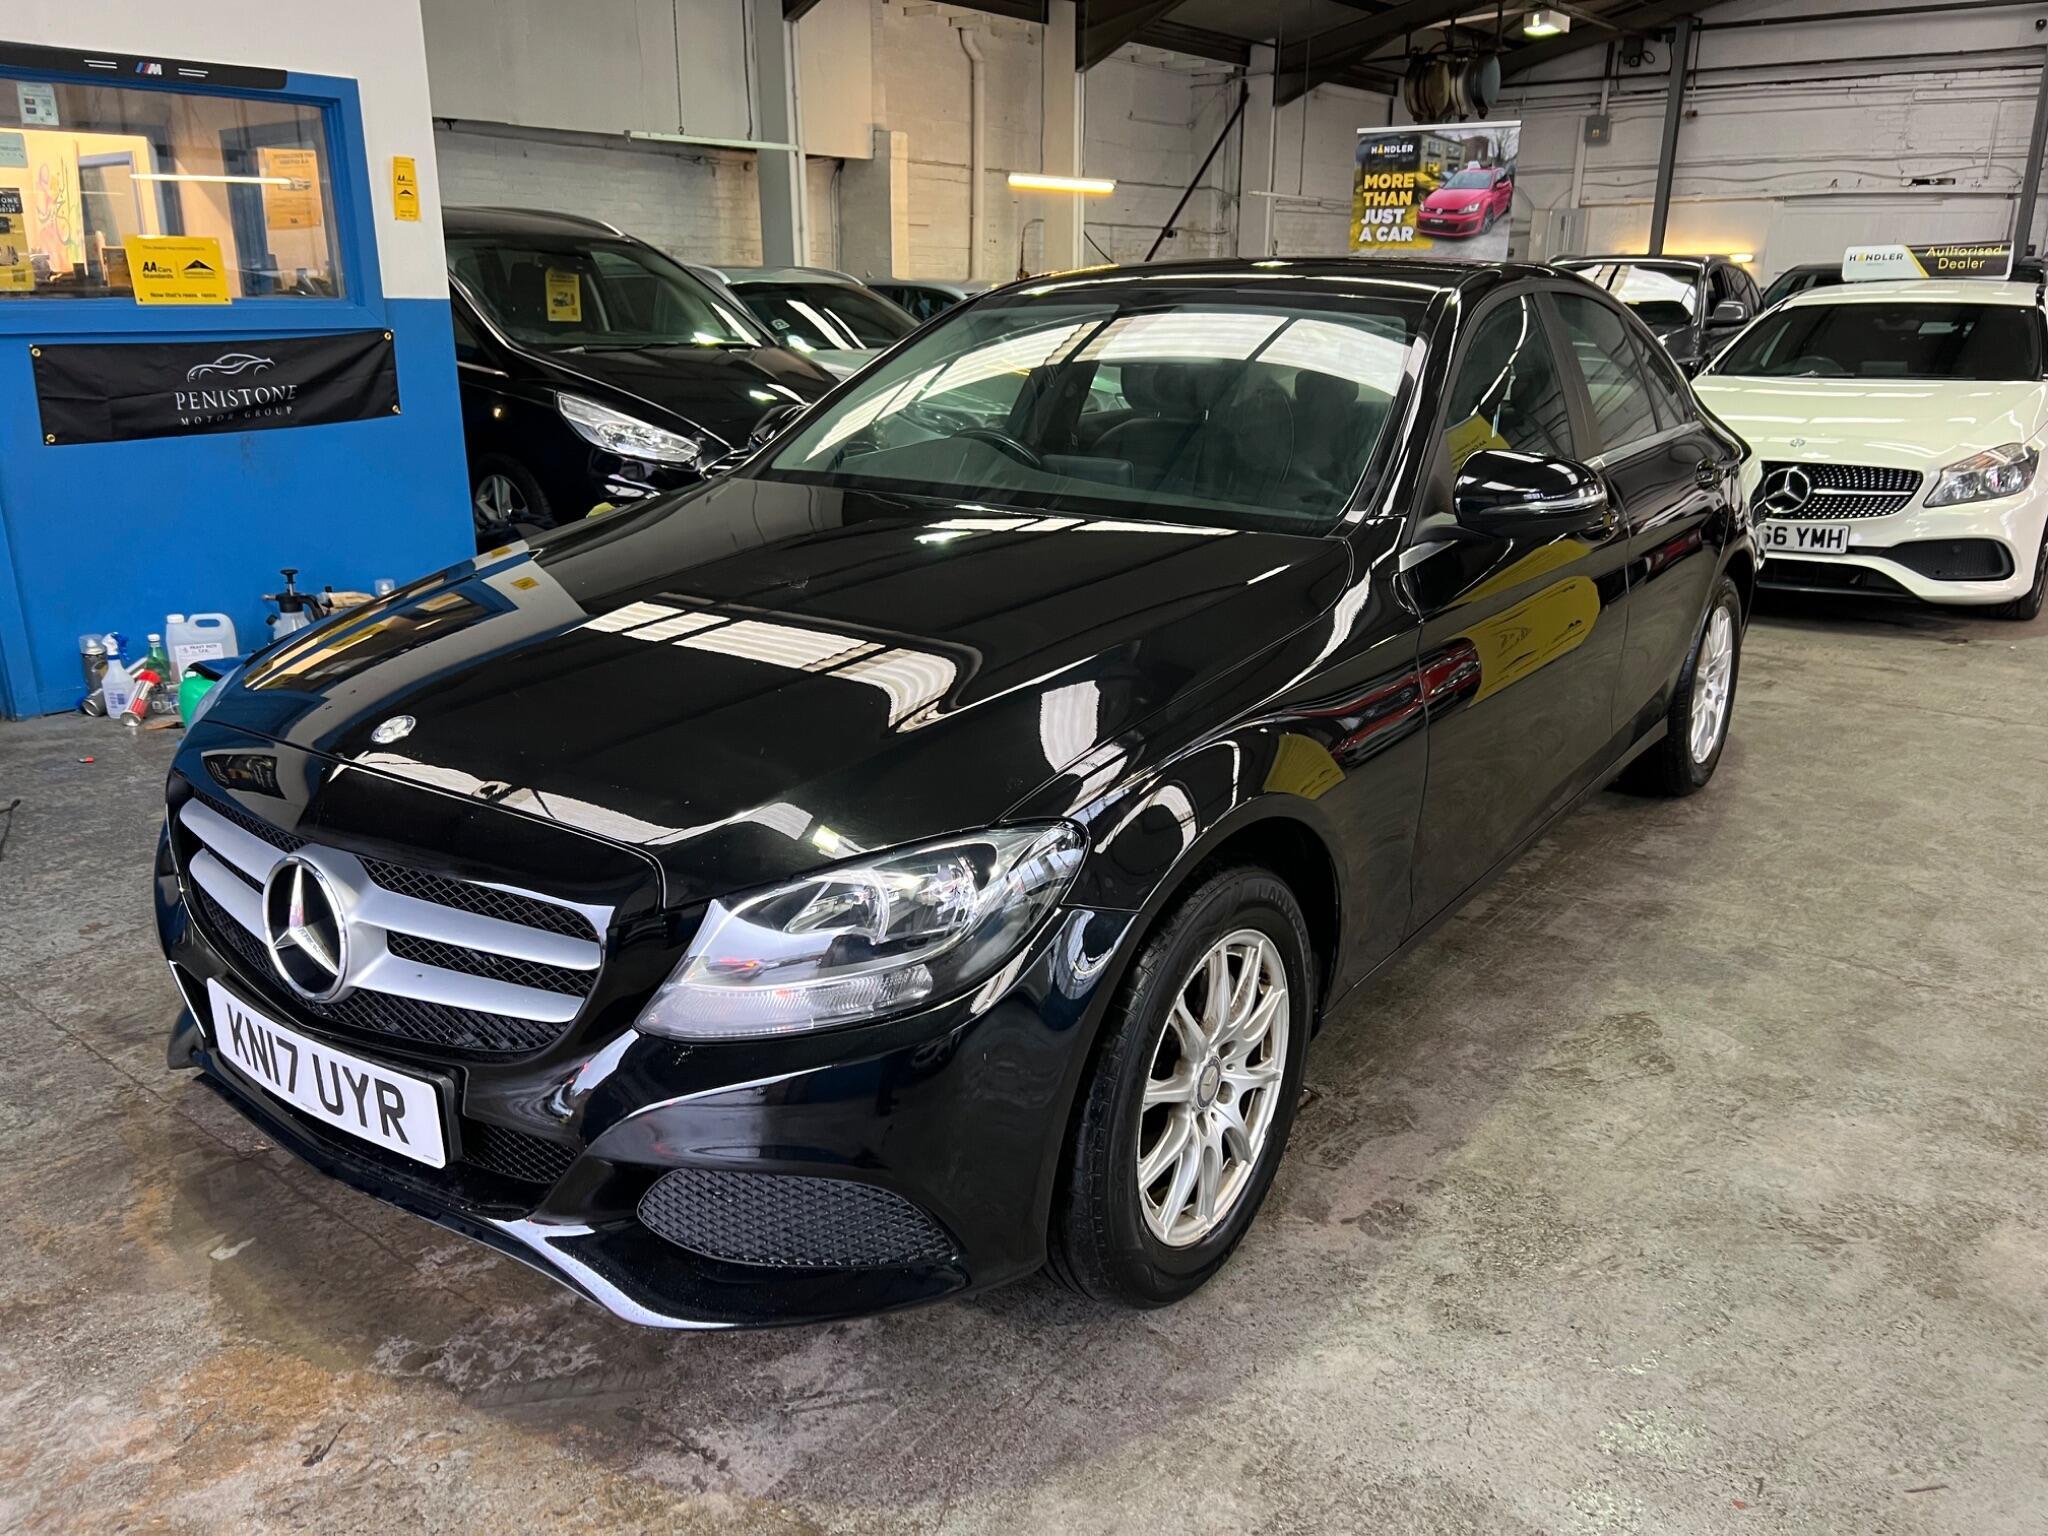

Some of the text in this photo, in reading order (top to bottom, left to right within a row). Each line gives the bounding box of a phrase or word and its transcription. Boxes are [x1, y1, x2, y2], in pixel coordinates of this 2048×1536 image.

[1364, 174, 1415, 190] MORE
[1363, 191, 1413, 207] THAN
[1361, 208, 1406, 225] JUST
[1359, 226, 1414, 242] A CAR
[1925, 244, 2003, 257] Authorised
[142, 261, 157, 273] AA
[1938, 256, 1986, 270] Dealer
[174, 384, 298, 411] PENISTONE
[180, 405, 294, 426] MOTOR GROUP
[1796, 527, 1844, 548] YMH
[226, 1003, 411, 1146] KN17 UYR
